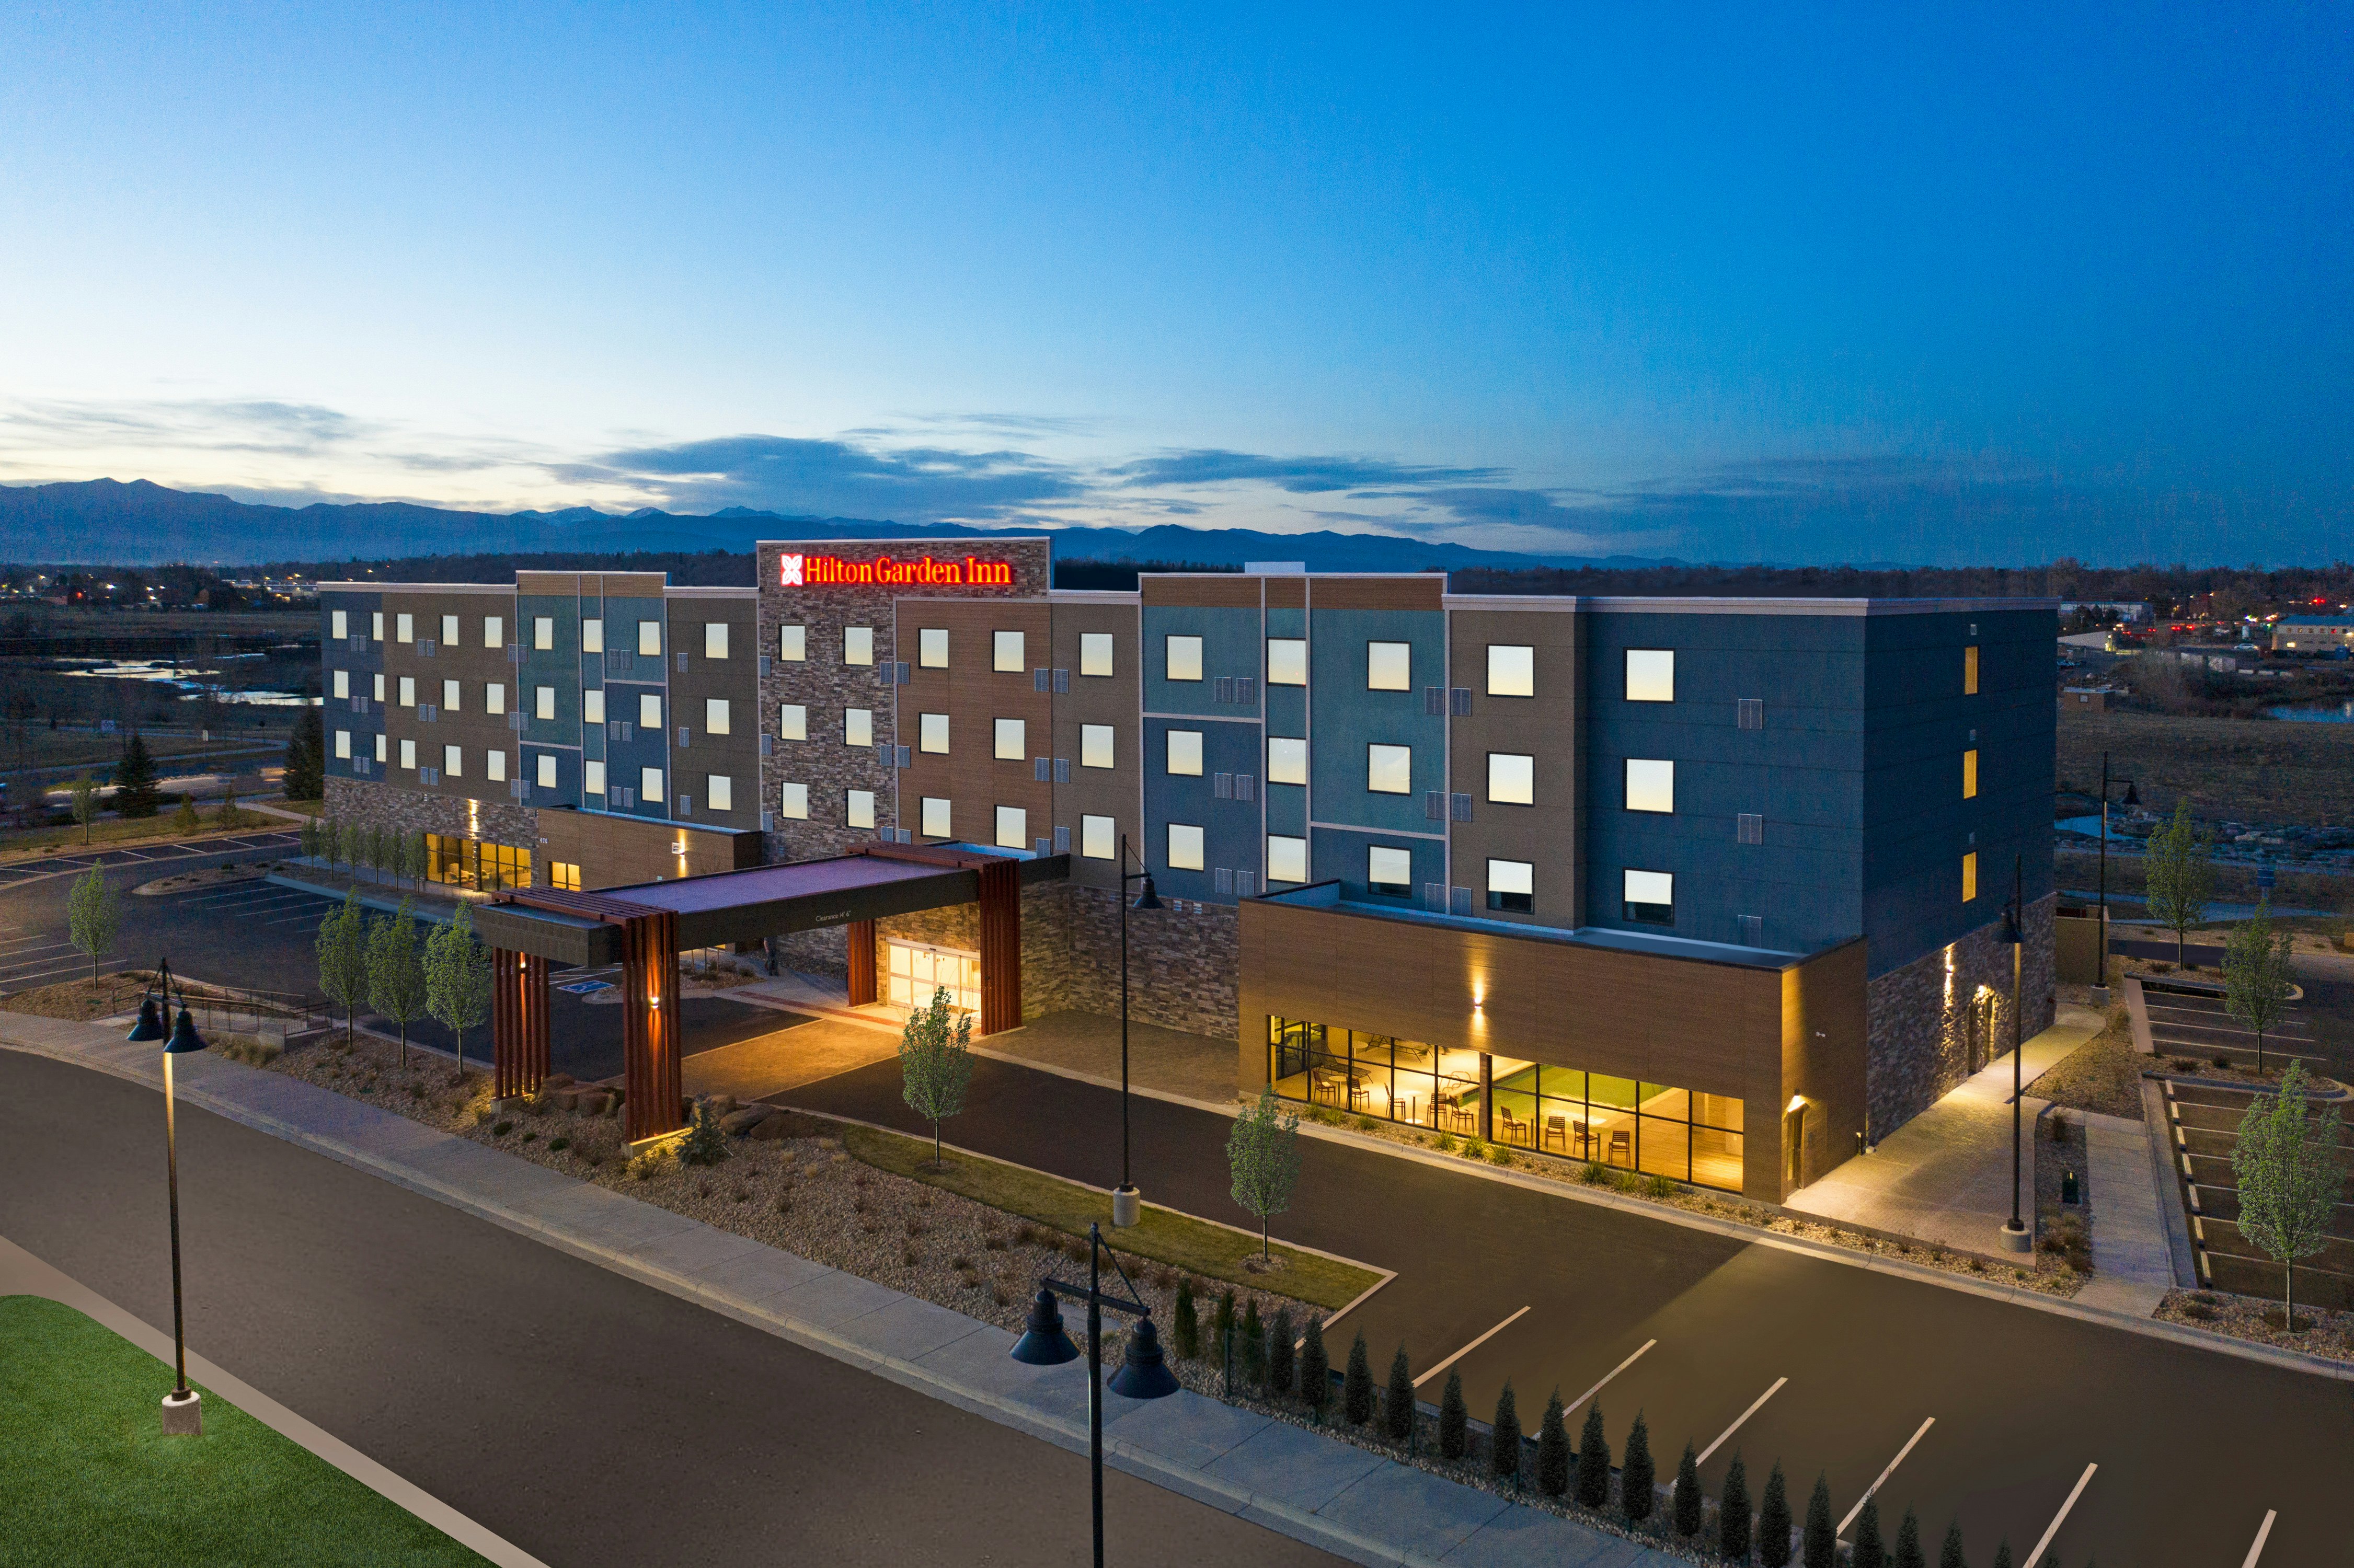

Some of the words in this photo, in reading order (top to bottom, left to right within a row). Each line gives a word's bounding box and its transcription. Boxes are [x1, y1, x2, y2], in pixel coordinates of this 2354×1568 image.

[805, 557, 872, 583] Hilton
[876, 557, 962, 583] Garden
[967, 557, 1012, 583] Inn
